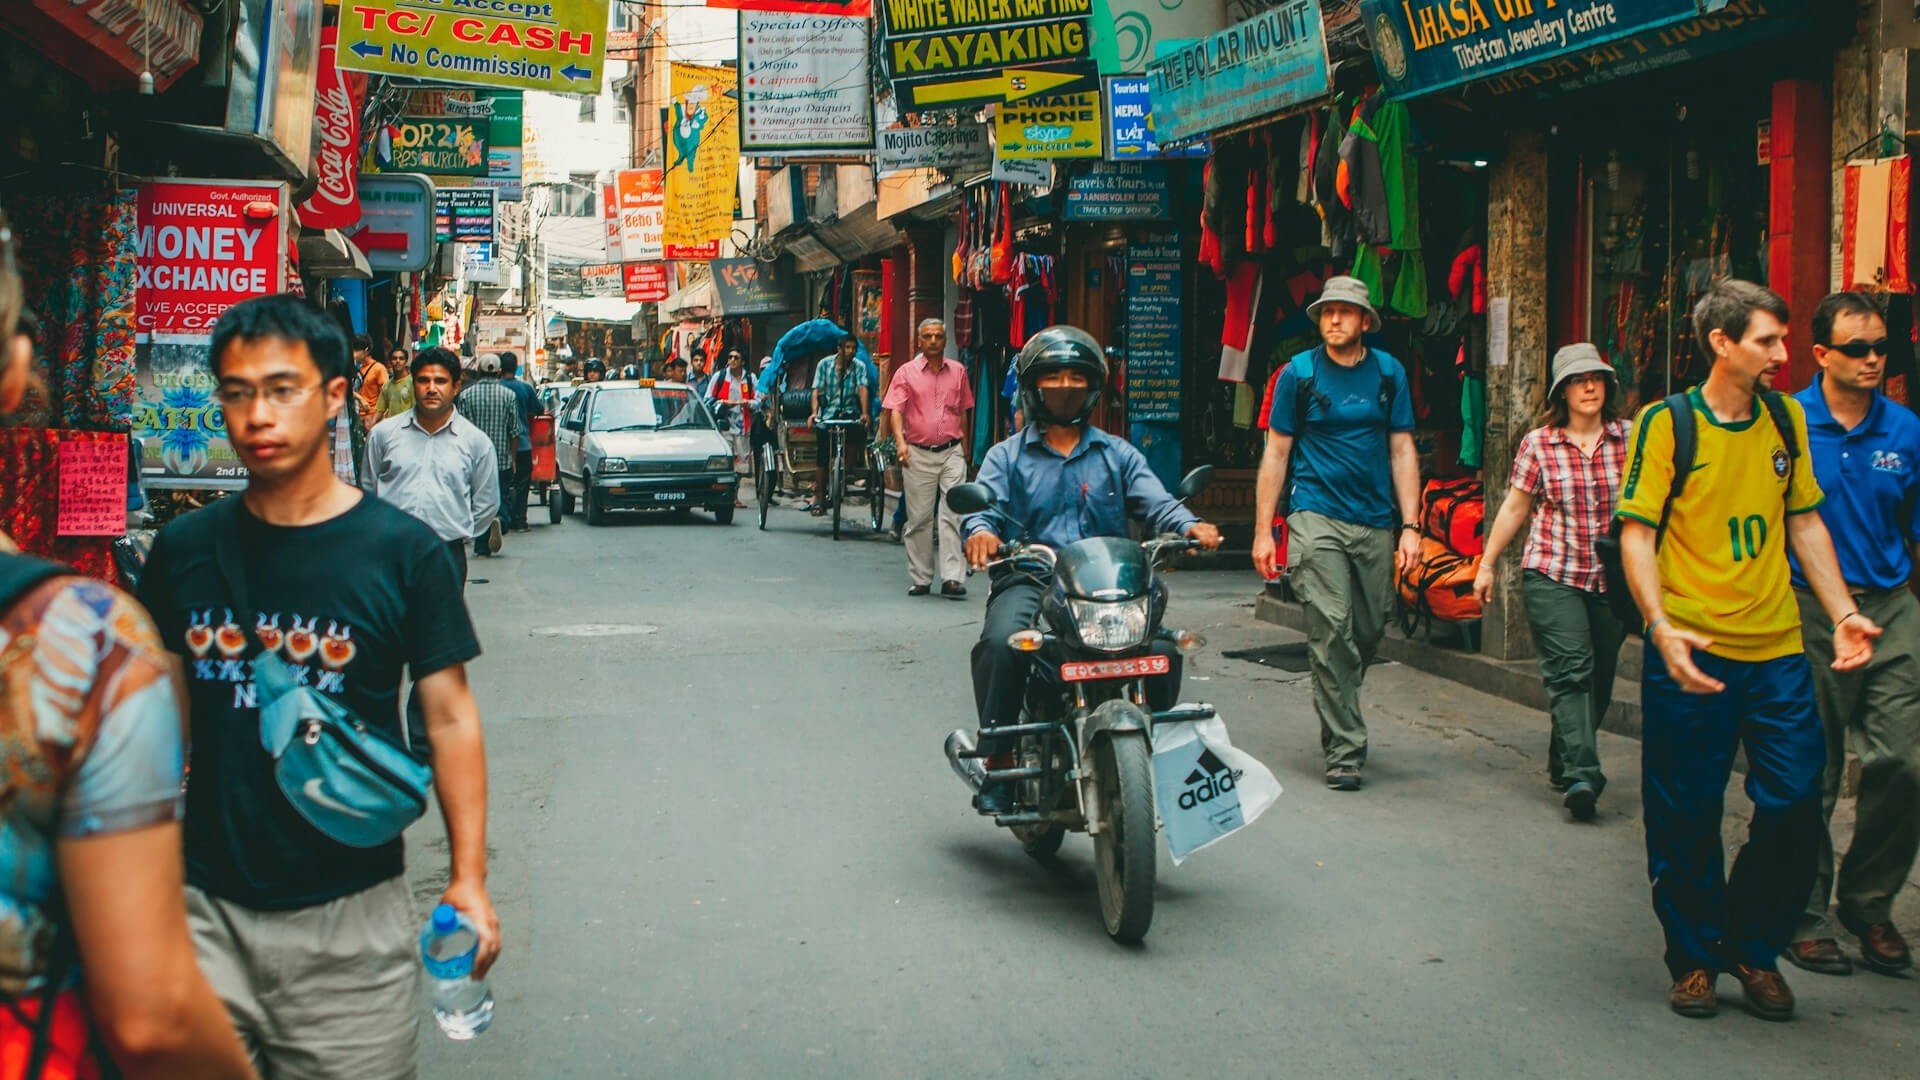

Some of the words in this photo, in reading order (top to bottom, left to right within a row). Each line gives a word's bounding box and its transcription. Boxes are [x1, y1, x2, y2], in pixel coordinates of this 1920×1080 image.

[888, 0, 948, 31] WHITE
[949, 0, 1012, 24] WATER
[354, 7, 436, 37] TC/
[452, 19, 592, 55] CASH
[746, 18, 807, 33] Special
[812, 16, 865, 32] Offers
[1403, 0, 1491, 50] LHASA
[1452, 37, 1507, 70] Tibetan
[1507, 15, 1566, 55] Jewellery
[1567, 2, 1617, 36] Centre
[893, 22, 1084, 73] KAYAKING
[1151, 53, 1185, 96] THE
[1185, 30, 1242, 84] POLAR
[1244, 4, 1311, 60] MOUNT
[391, 43, 419, 64] No
[426, 48, 552, 80] Commission
[761, 60, 798, 74] Mojito
[800, 89, 838, 101] Delight
[1114, 83, 1138, 94] Tourist
[761, 104, 801, 116] Mango
[1002, 95, 1093, 108] E-MAIL
[1003, 110, 1094, 124] PHONE
[1115, 104, 1144, 118] NEPAL
[1025, 124, 1070, 142] skype
[316, 86, 355, 205] Coca-Cola
[884, 132, 922, 155] Mojito
[1069, 176, 1105, 189] Travels
[1115, 176, 1146, 189] Tours
[210, 191, 229, 200] Govt.
[231, 191, 272, 202] Authorized
[152, 203, 238, 218] UNIVERSAL
[136, 225, 262, 262] MONEY
[136, 264, 267, 293] XCHANGE
[146, 302, 170, 312] WE
[174, 302, 236, 314] ACCEP
[183, 316, 216, 328] CA
[216, 467, 235, 477] 2nd
[1727, 514, 1767, 562] 10
[1178, 767, 1246, 810] adid
